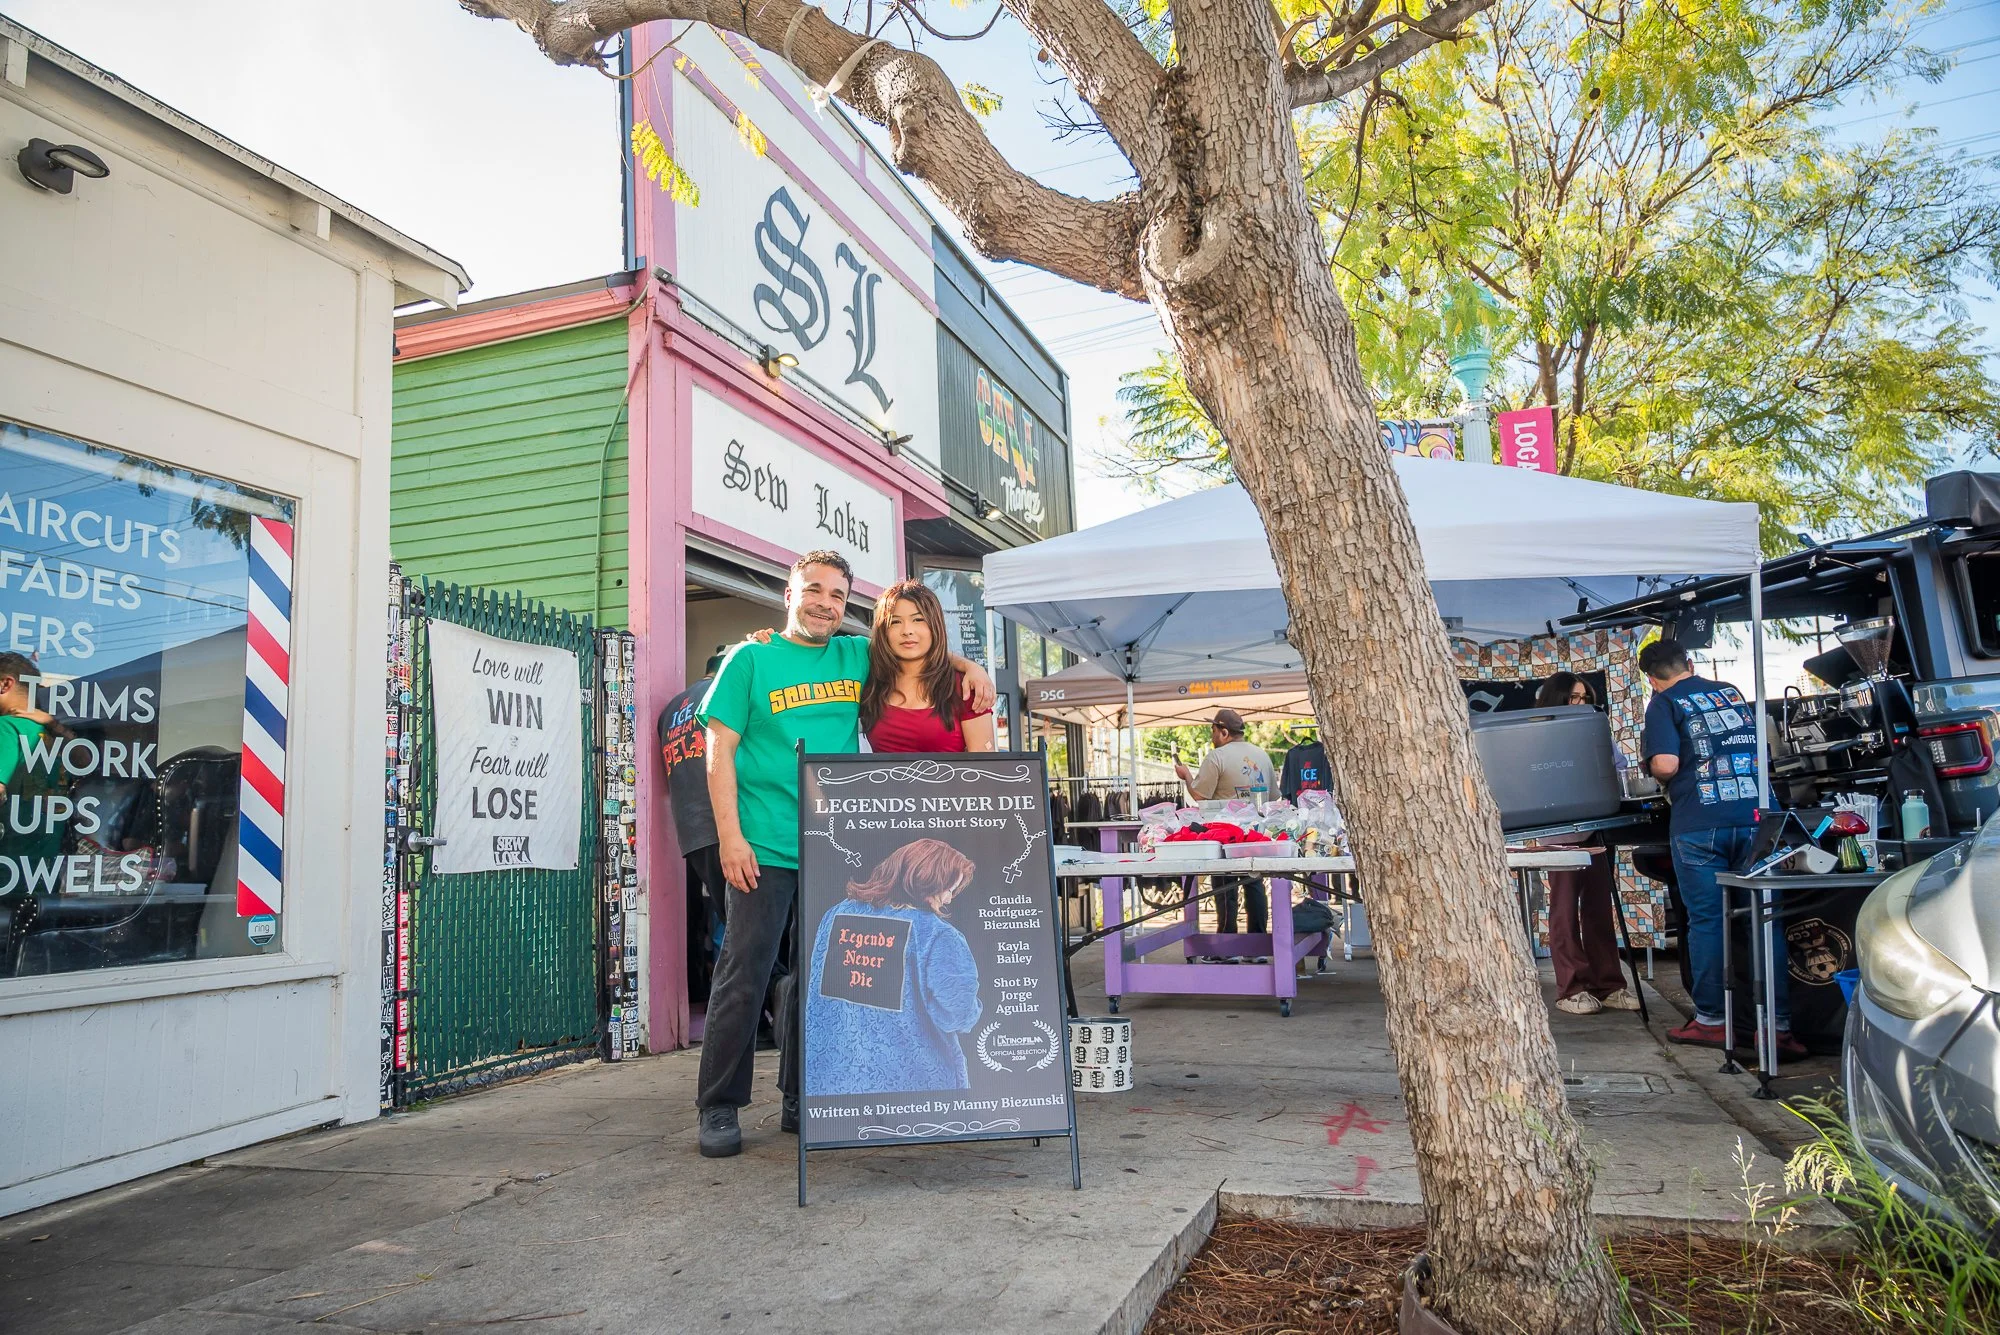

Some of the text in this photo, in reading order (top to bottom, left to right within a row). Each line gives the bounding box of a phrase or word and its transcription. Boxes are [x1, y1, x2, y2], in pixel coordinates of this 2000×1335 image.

[722, 439, 870, 553] Sew Loka
[0, 491, 181, 564] AIRCUTS
[0, 550, 142, 610] FADES
[472, 648, 544, 685] Love will
[18, 674, 156, 724] TRIMS
[1040, 689, 1065, 701] DSG
[486, 688, 543, 730] WIN
[669, 702, 694, 729] ICE
[18, 734, 157, 779] WORK
[469, 746, 549, 778] Fear will
[1300, 768, 1318, 781] ICE
[472, 786, 538, 820] LOSE
[815, 795, 1036, 814] LEGENDS NEVER DIE
[9, 794, 101, 835] UPS
[845, 816, 1008, 830] A Sew Loka Short Story
[496, 836, 526, 851] SEW
[494, 850, 532, 865] LOKA
[989, 894, 1032, 905] Claudia
[978, 907, 1044, 919] Rodríguez-
[254, 922, 270, 934] ring
[983, 918, 1041, 930] Biezunski
[838, 928, 896, 949] Legends
[997, 941, 1030, 953] Kayla
[842, 949, 885, 968] Never
[996, 953, 1033, 965] Bailey
[849, 970, 873, 988] Die
[993, 977, 1039, 988] Shot By
[1001, 991, 1033, 1002] Jorge
[995, 1002, 1040, 1015] Aguilar
[808, 1094, 1065, 1119] Written & Directed By Manny Biezunski
